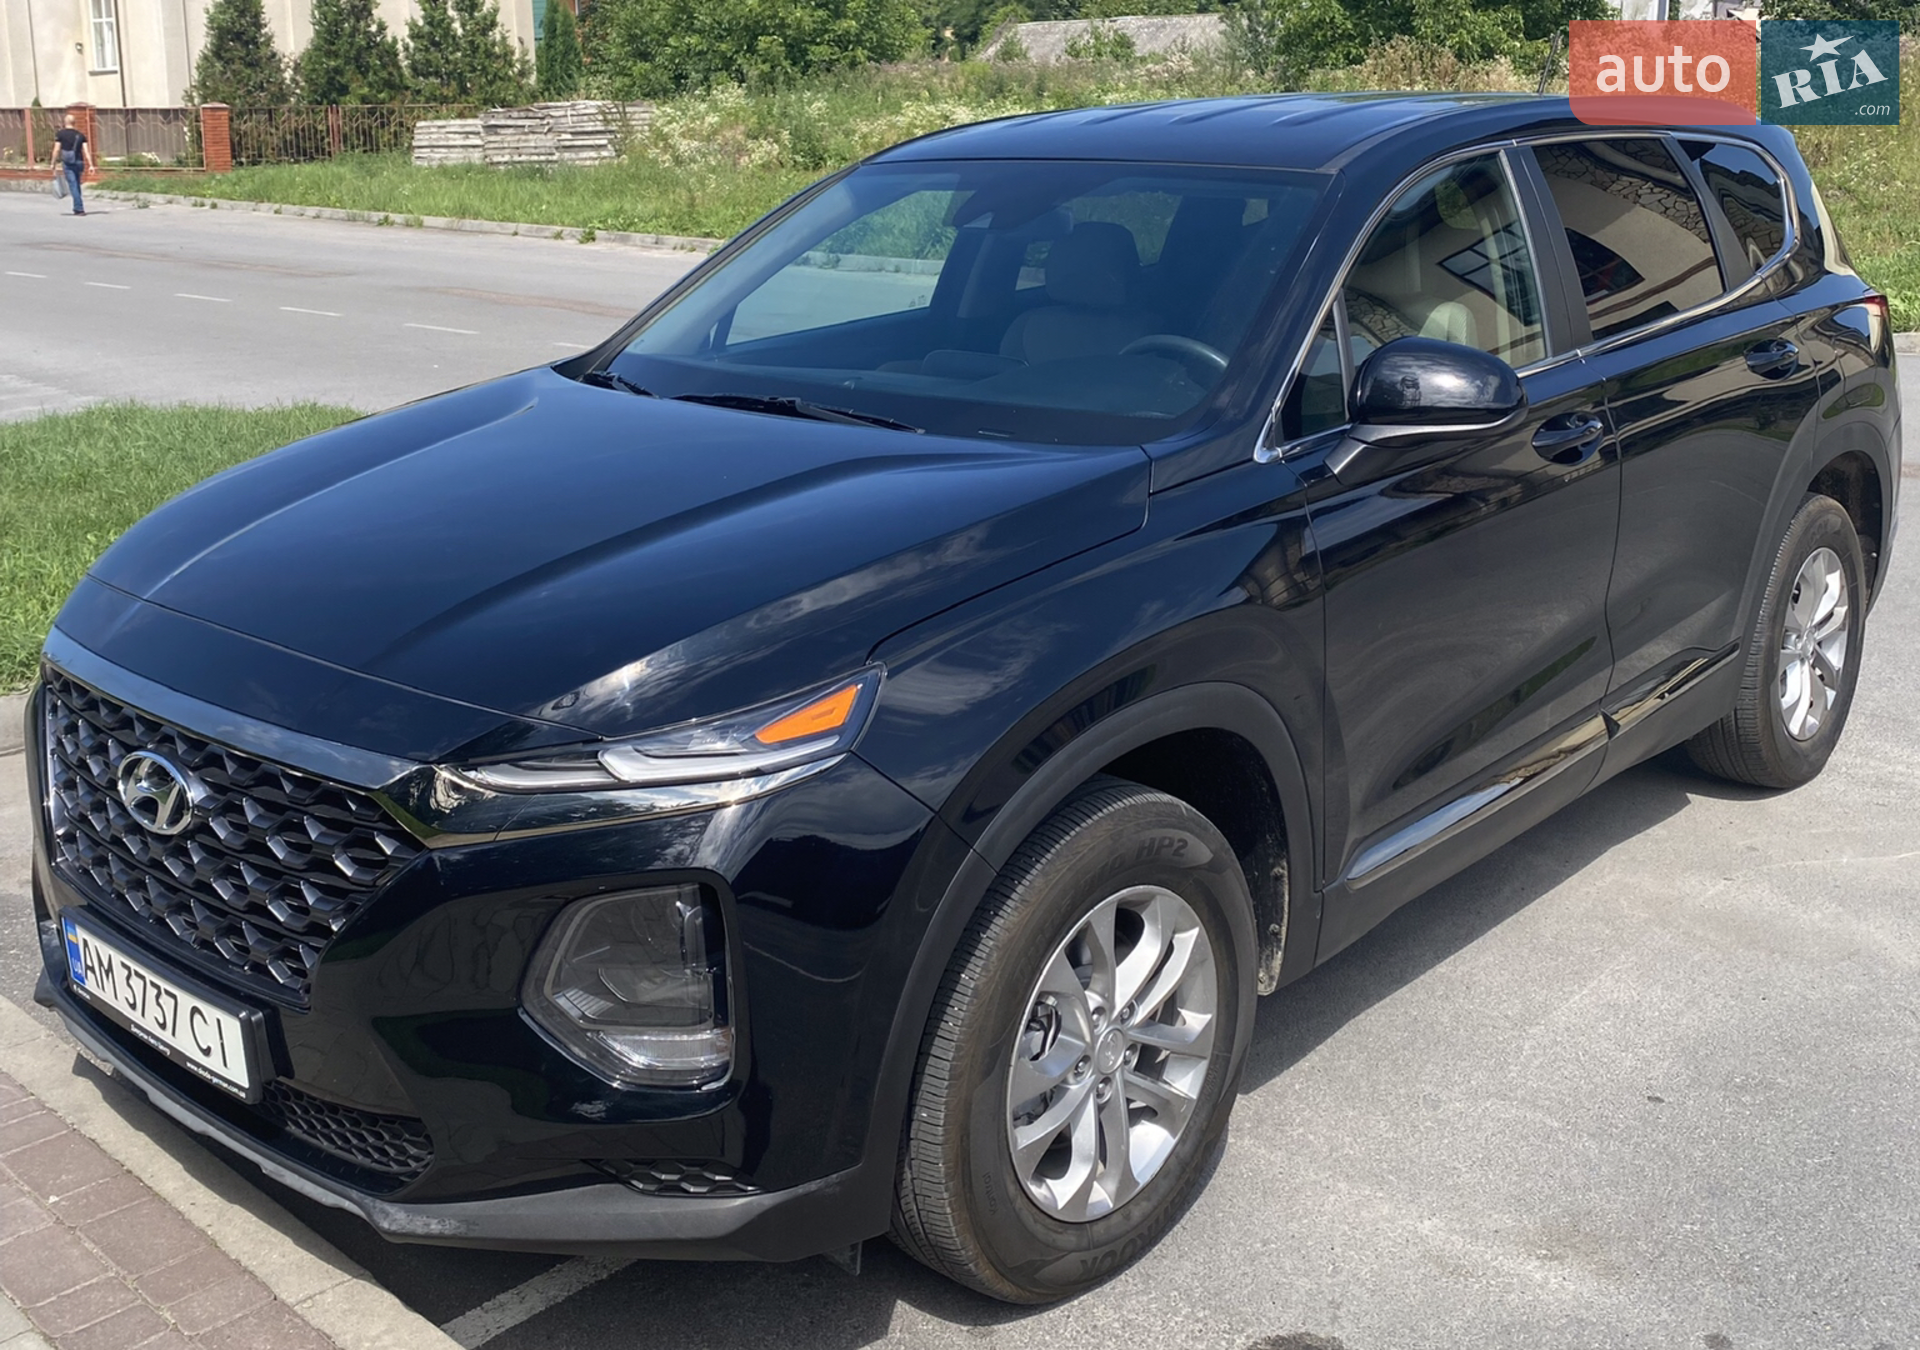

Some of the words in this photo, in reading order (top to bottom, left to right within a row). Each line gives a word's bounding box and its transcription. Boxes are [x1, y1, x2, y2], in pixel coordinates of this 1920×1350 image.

[1135, 835, 1190, 862] HP2
[82, 937, 119, 1001] AM
[120, 959, 178, 1039] 3737
[189, 1005, 230, 1070] CI
